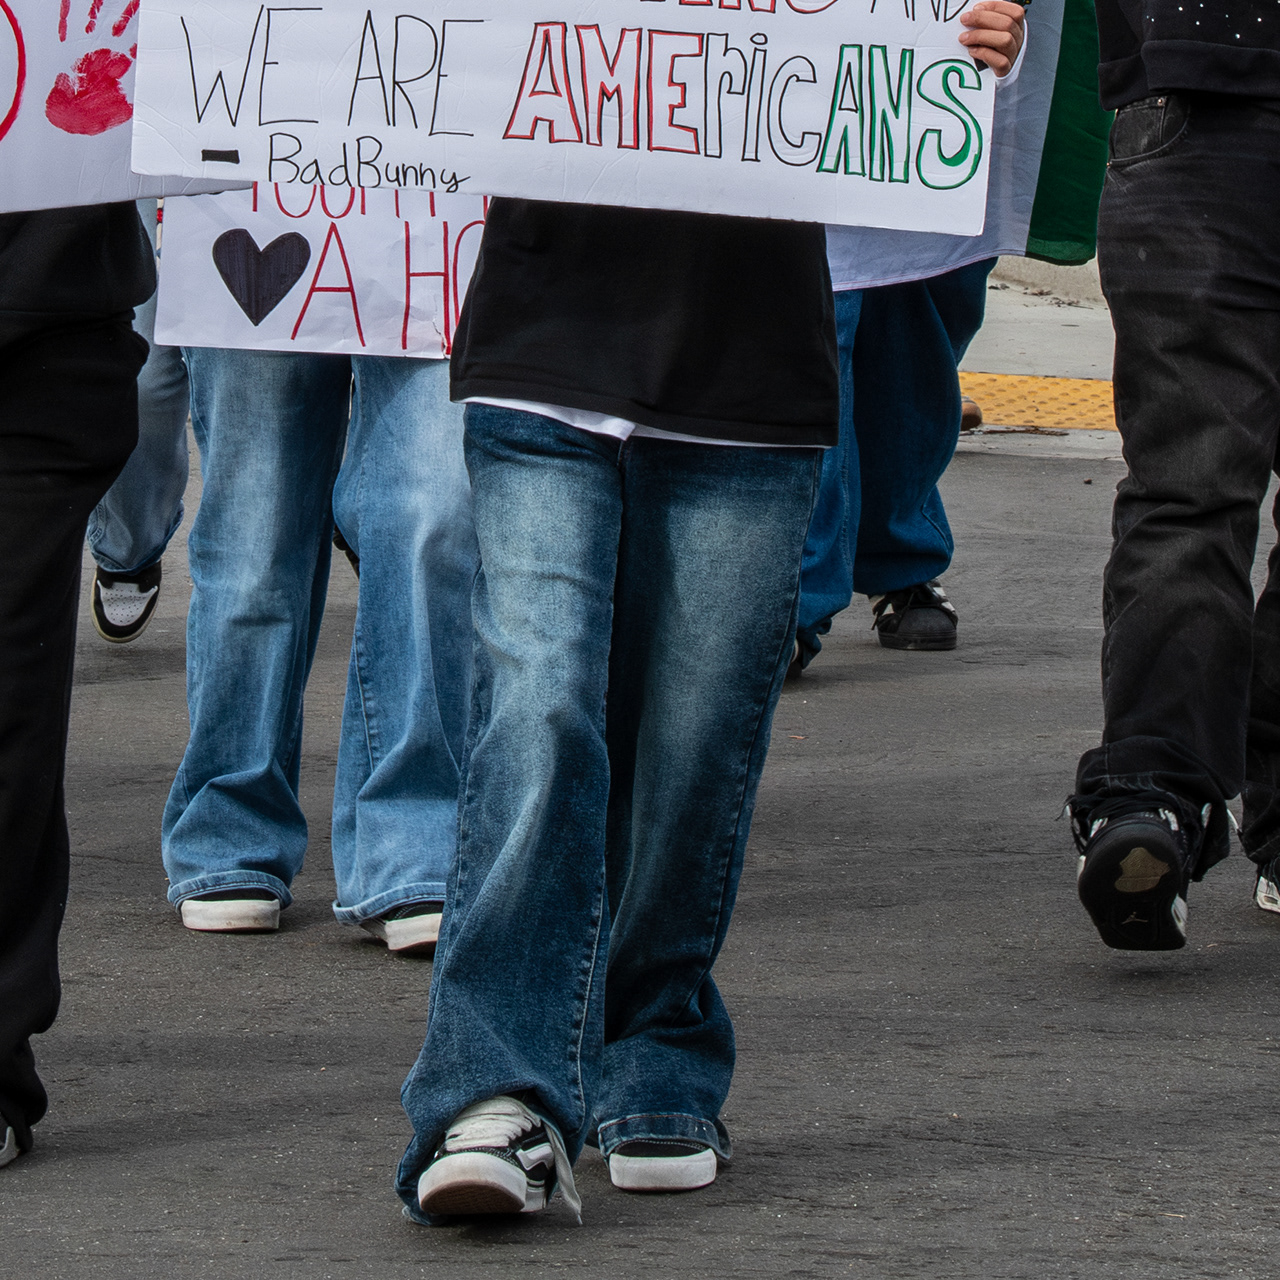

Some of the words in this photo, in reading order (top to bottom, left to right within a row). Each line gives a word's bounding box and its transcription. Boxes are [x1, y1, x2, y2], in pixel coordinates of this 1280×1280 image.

[181, 4, 323, 128] WE
[347, 9, 494, 138] ARE
[291, 221, 367, 348] A
